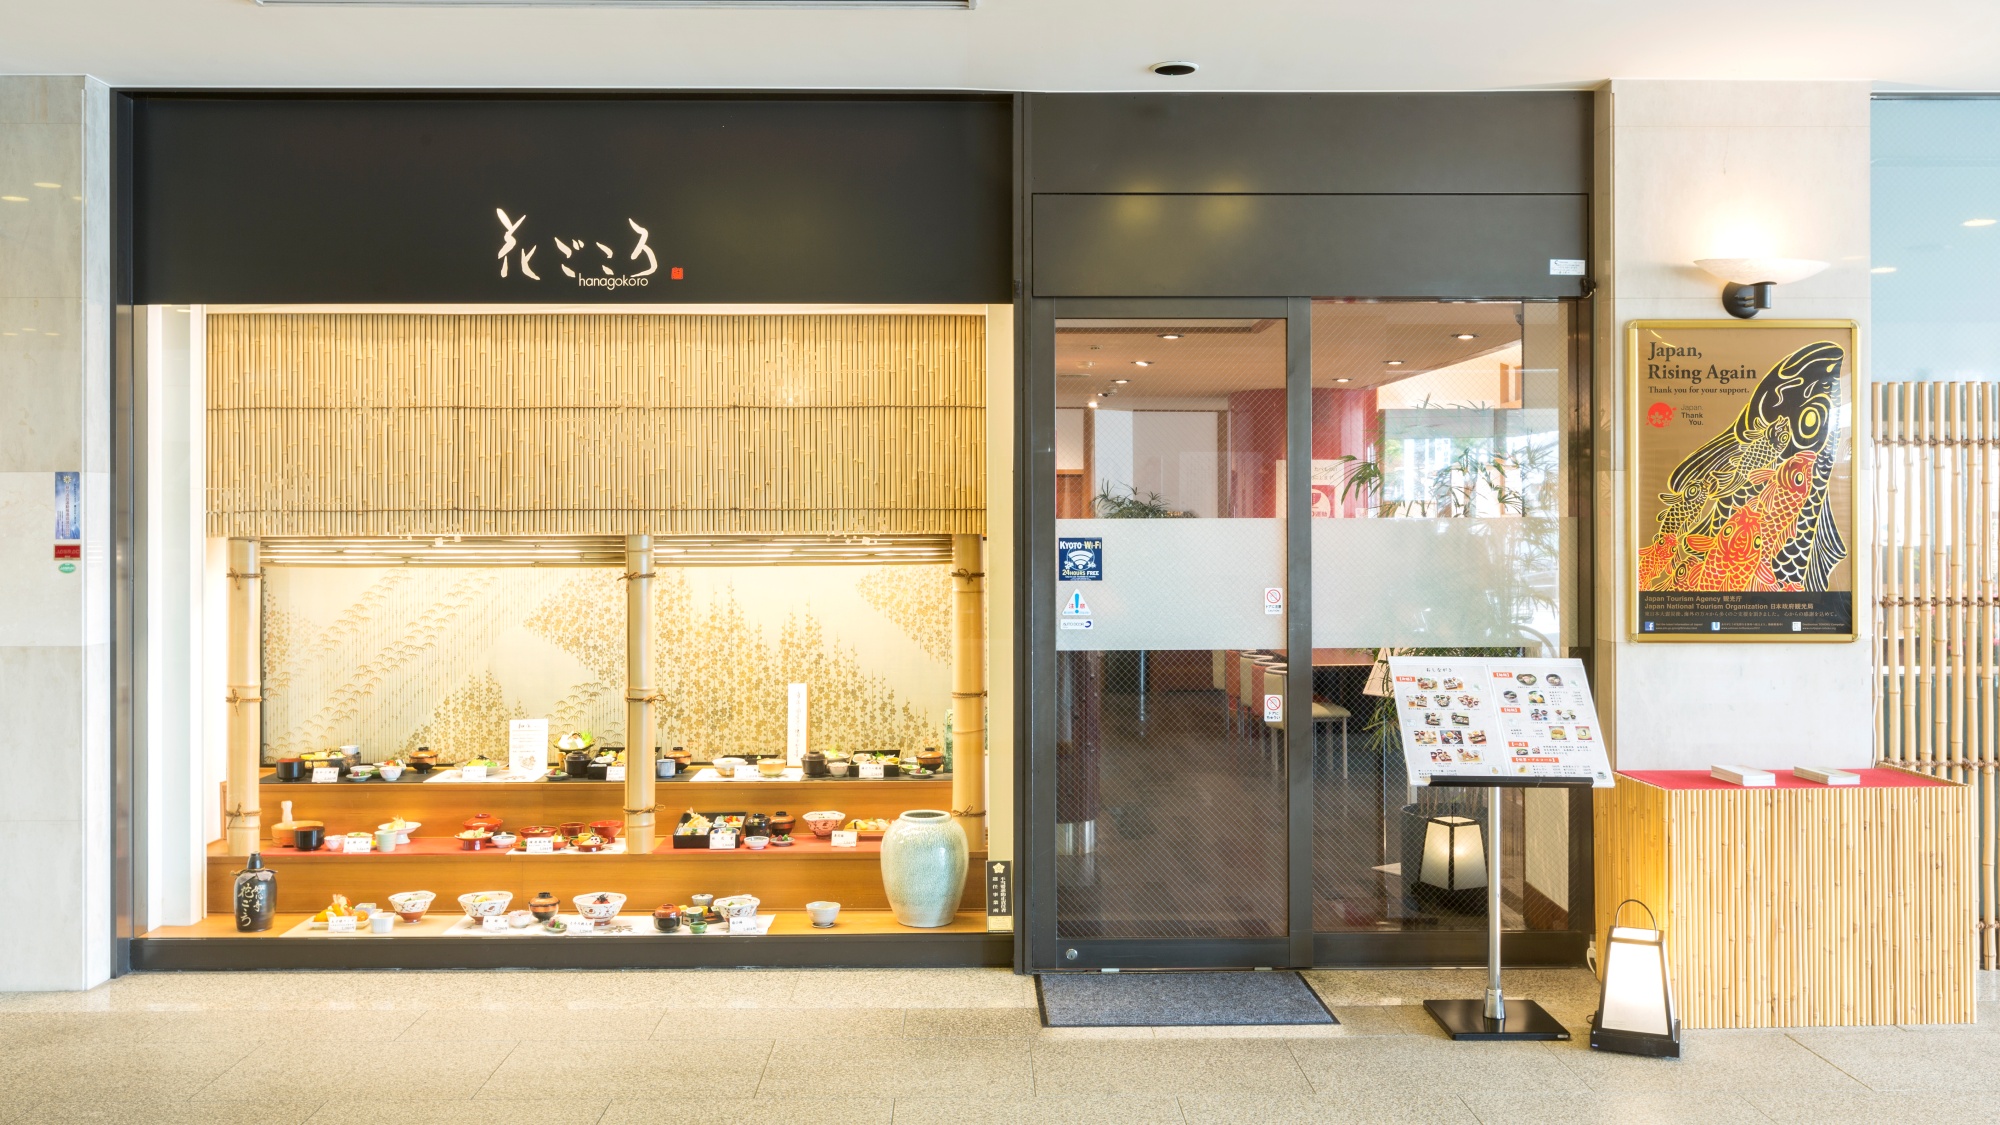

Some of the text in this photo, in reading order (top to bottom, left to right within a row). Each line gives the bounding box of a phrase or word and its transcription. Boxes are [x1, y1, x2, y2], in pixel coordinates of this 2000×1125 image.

[496, 207, 658, 281] 花ごころ
[578, 273, 649, 290] hanagokoro
[1647, 341, 1703, 362] Japan,
[1648, 364, 1757, 384] Rising Again
[1648, 385, 1750, 395] Thank you for your support.
[1060, 541, 1082, 549] KYOTO
[238, 883, 254, 927] 花ごころ
